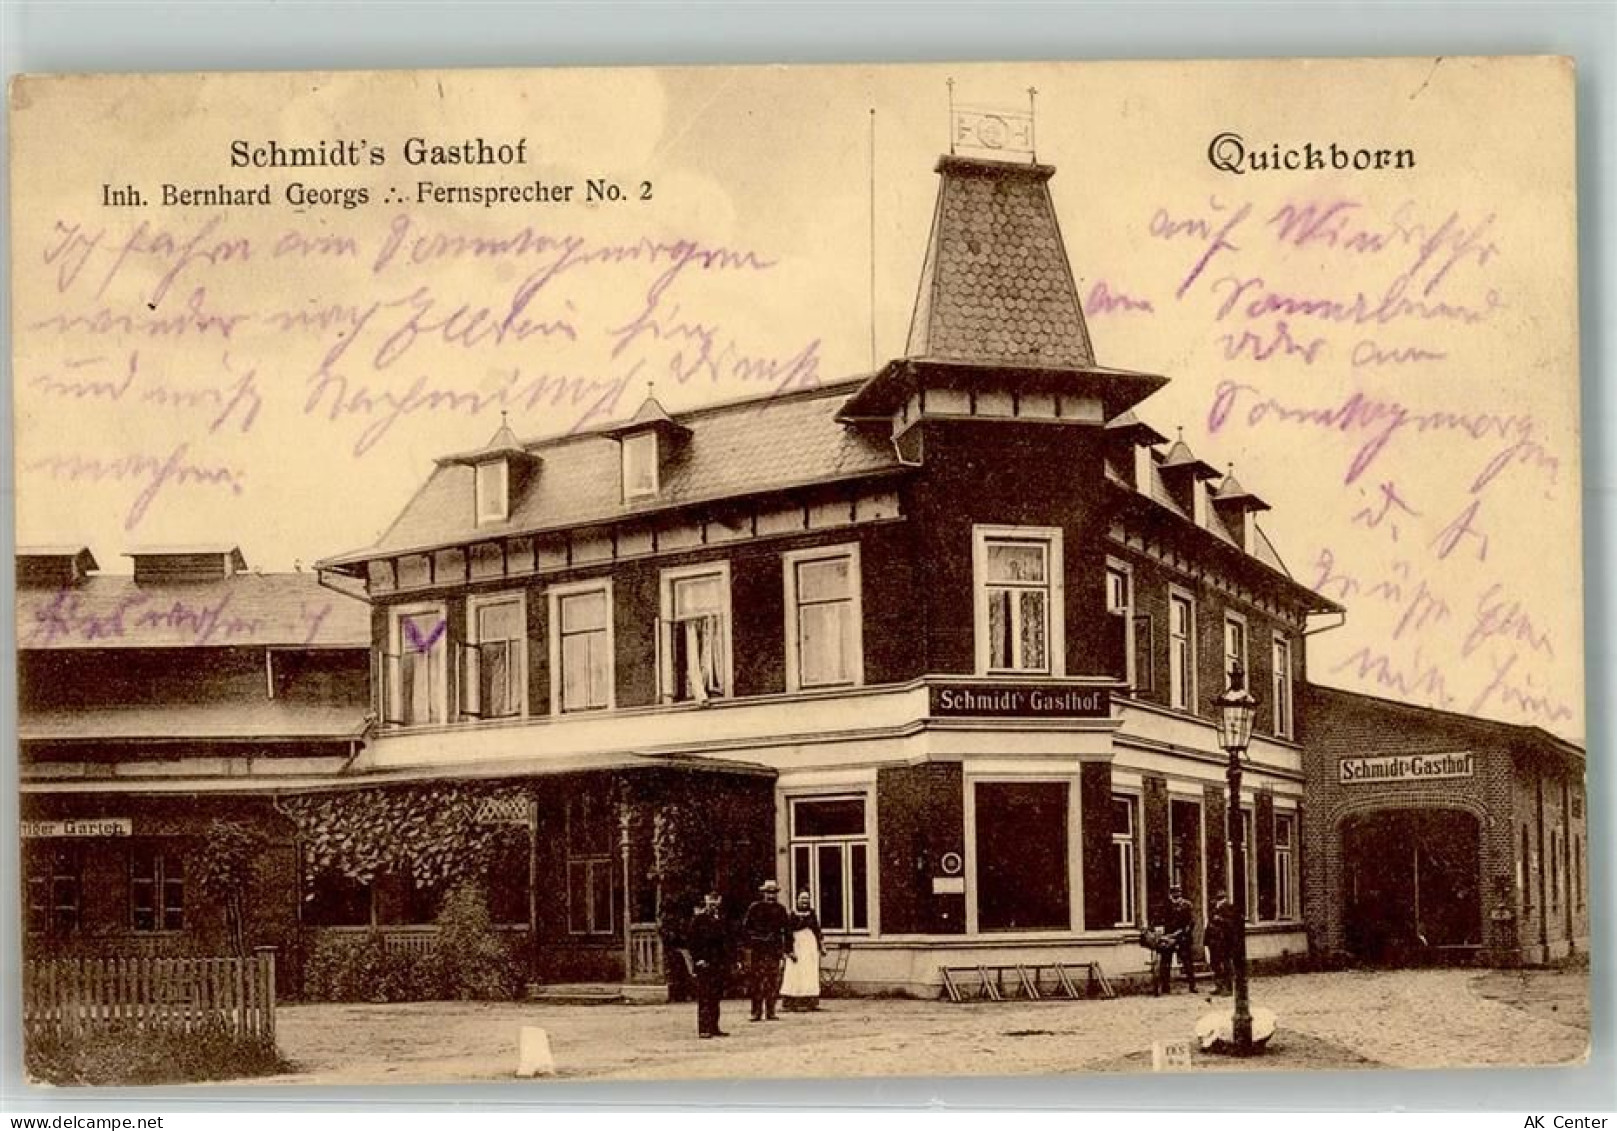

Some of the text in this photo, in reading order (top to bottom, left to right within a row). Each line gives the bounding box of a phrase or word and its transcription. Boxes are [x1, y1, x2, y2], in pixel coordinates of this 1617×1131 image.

[231, 137, 528, 168] Schmidt's Gasthof
[1207, 131, 1417, 175] Quickborn
[102, 178, 654, 209] Inh. Bernhard Georgs Fernsprecher No. 2
[1411, 753, 1473, 777] Gasthof
